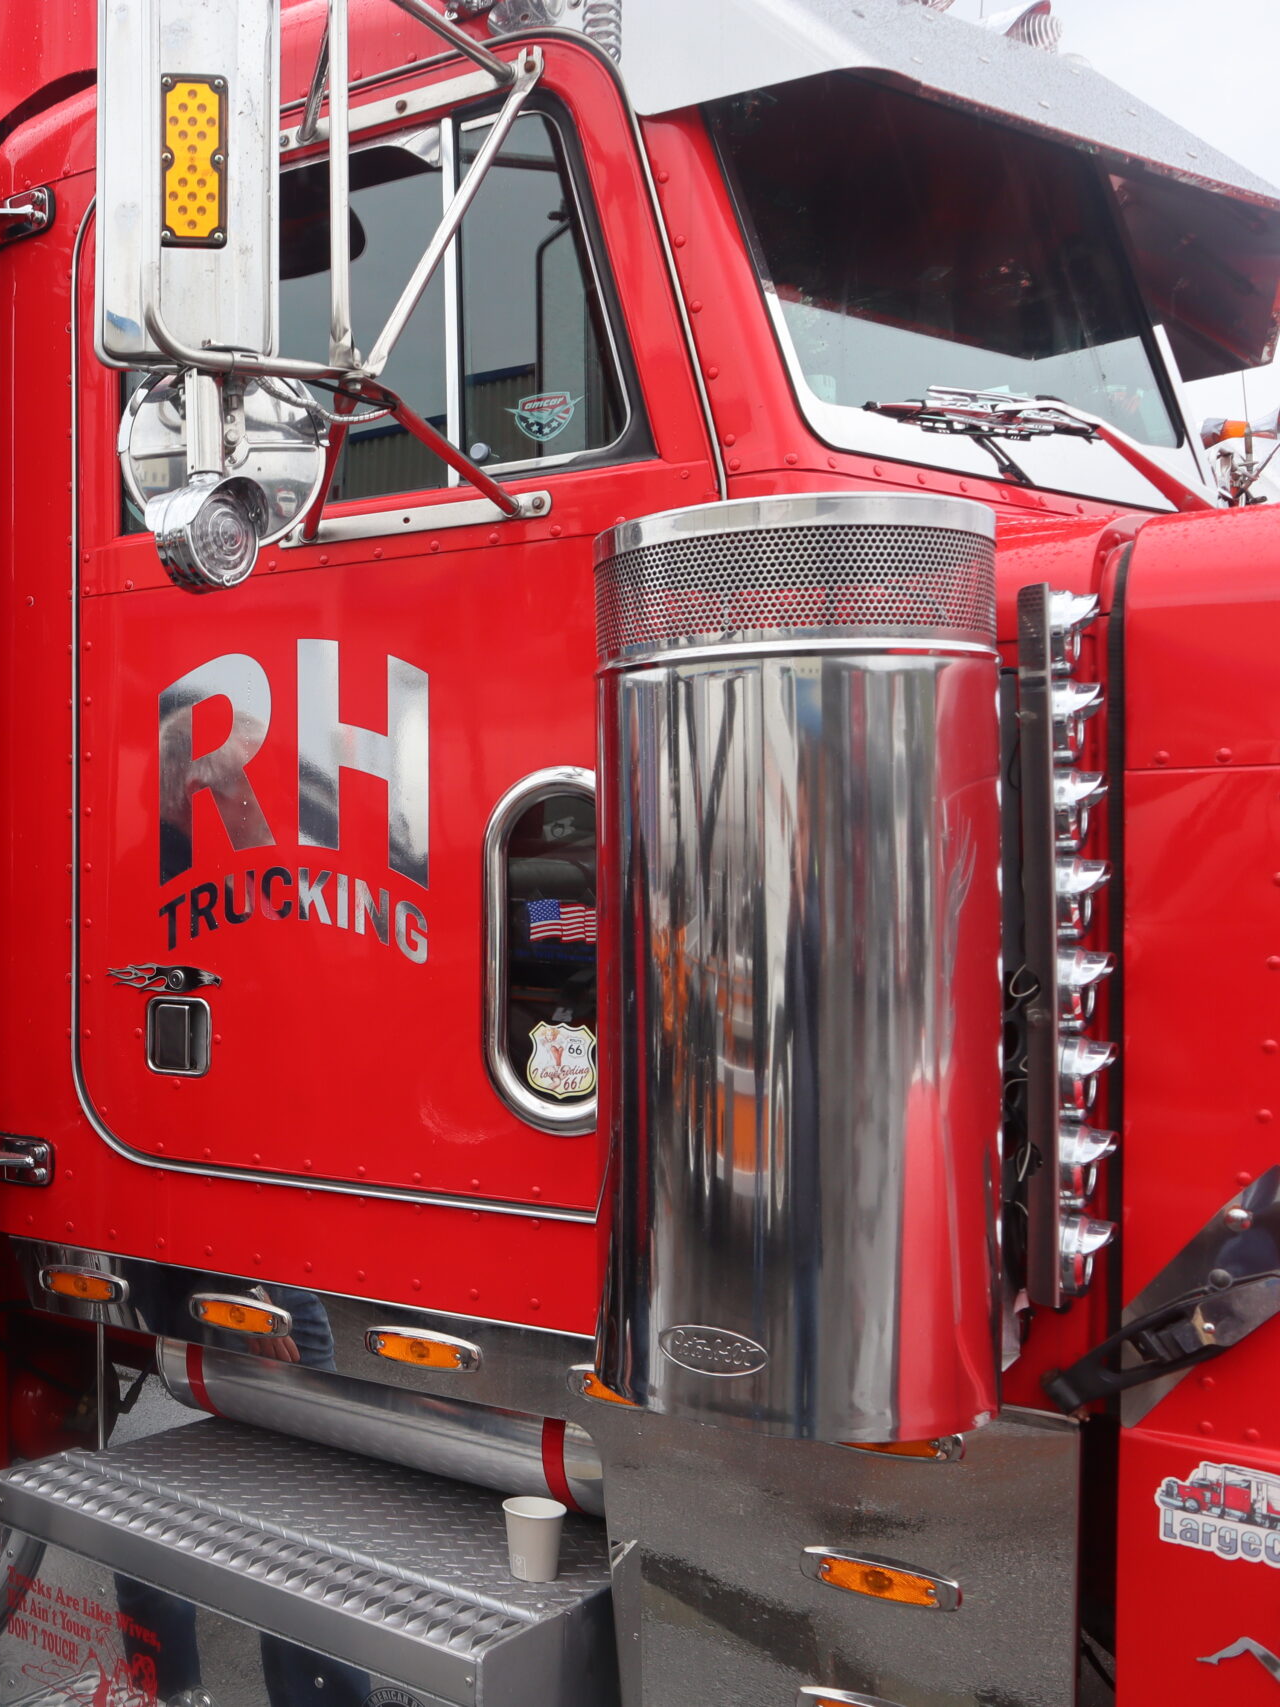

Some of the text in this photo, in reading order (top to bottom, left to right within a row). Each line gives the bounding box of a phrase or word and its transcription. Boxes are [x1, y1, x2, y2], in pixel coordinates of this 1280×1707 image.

[158, 638, 430, 891] RH
[158, 865, 429, 965] TRUCKING
[568, 1044, 583, 1056] 66
[6, 1564, 162, 1652] Trucks Are Like Wives,
[6, 1612, 80, 1665] DON'T TOUCH!
[59, 1606, 92, 1643] Yours
